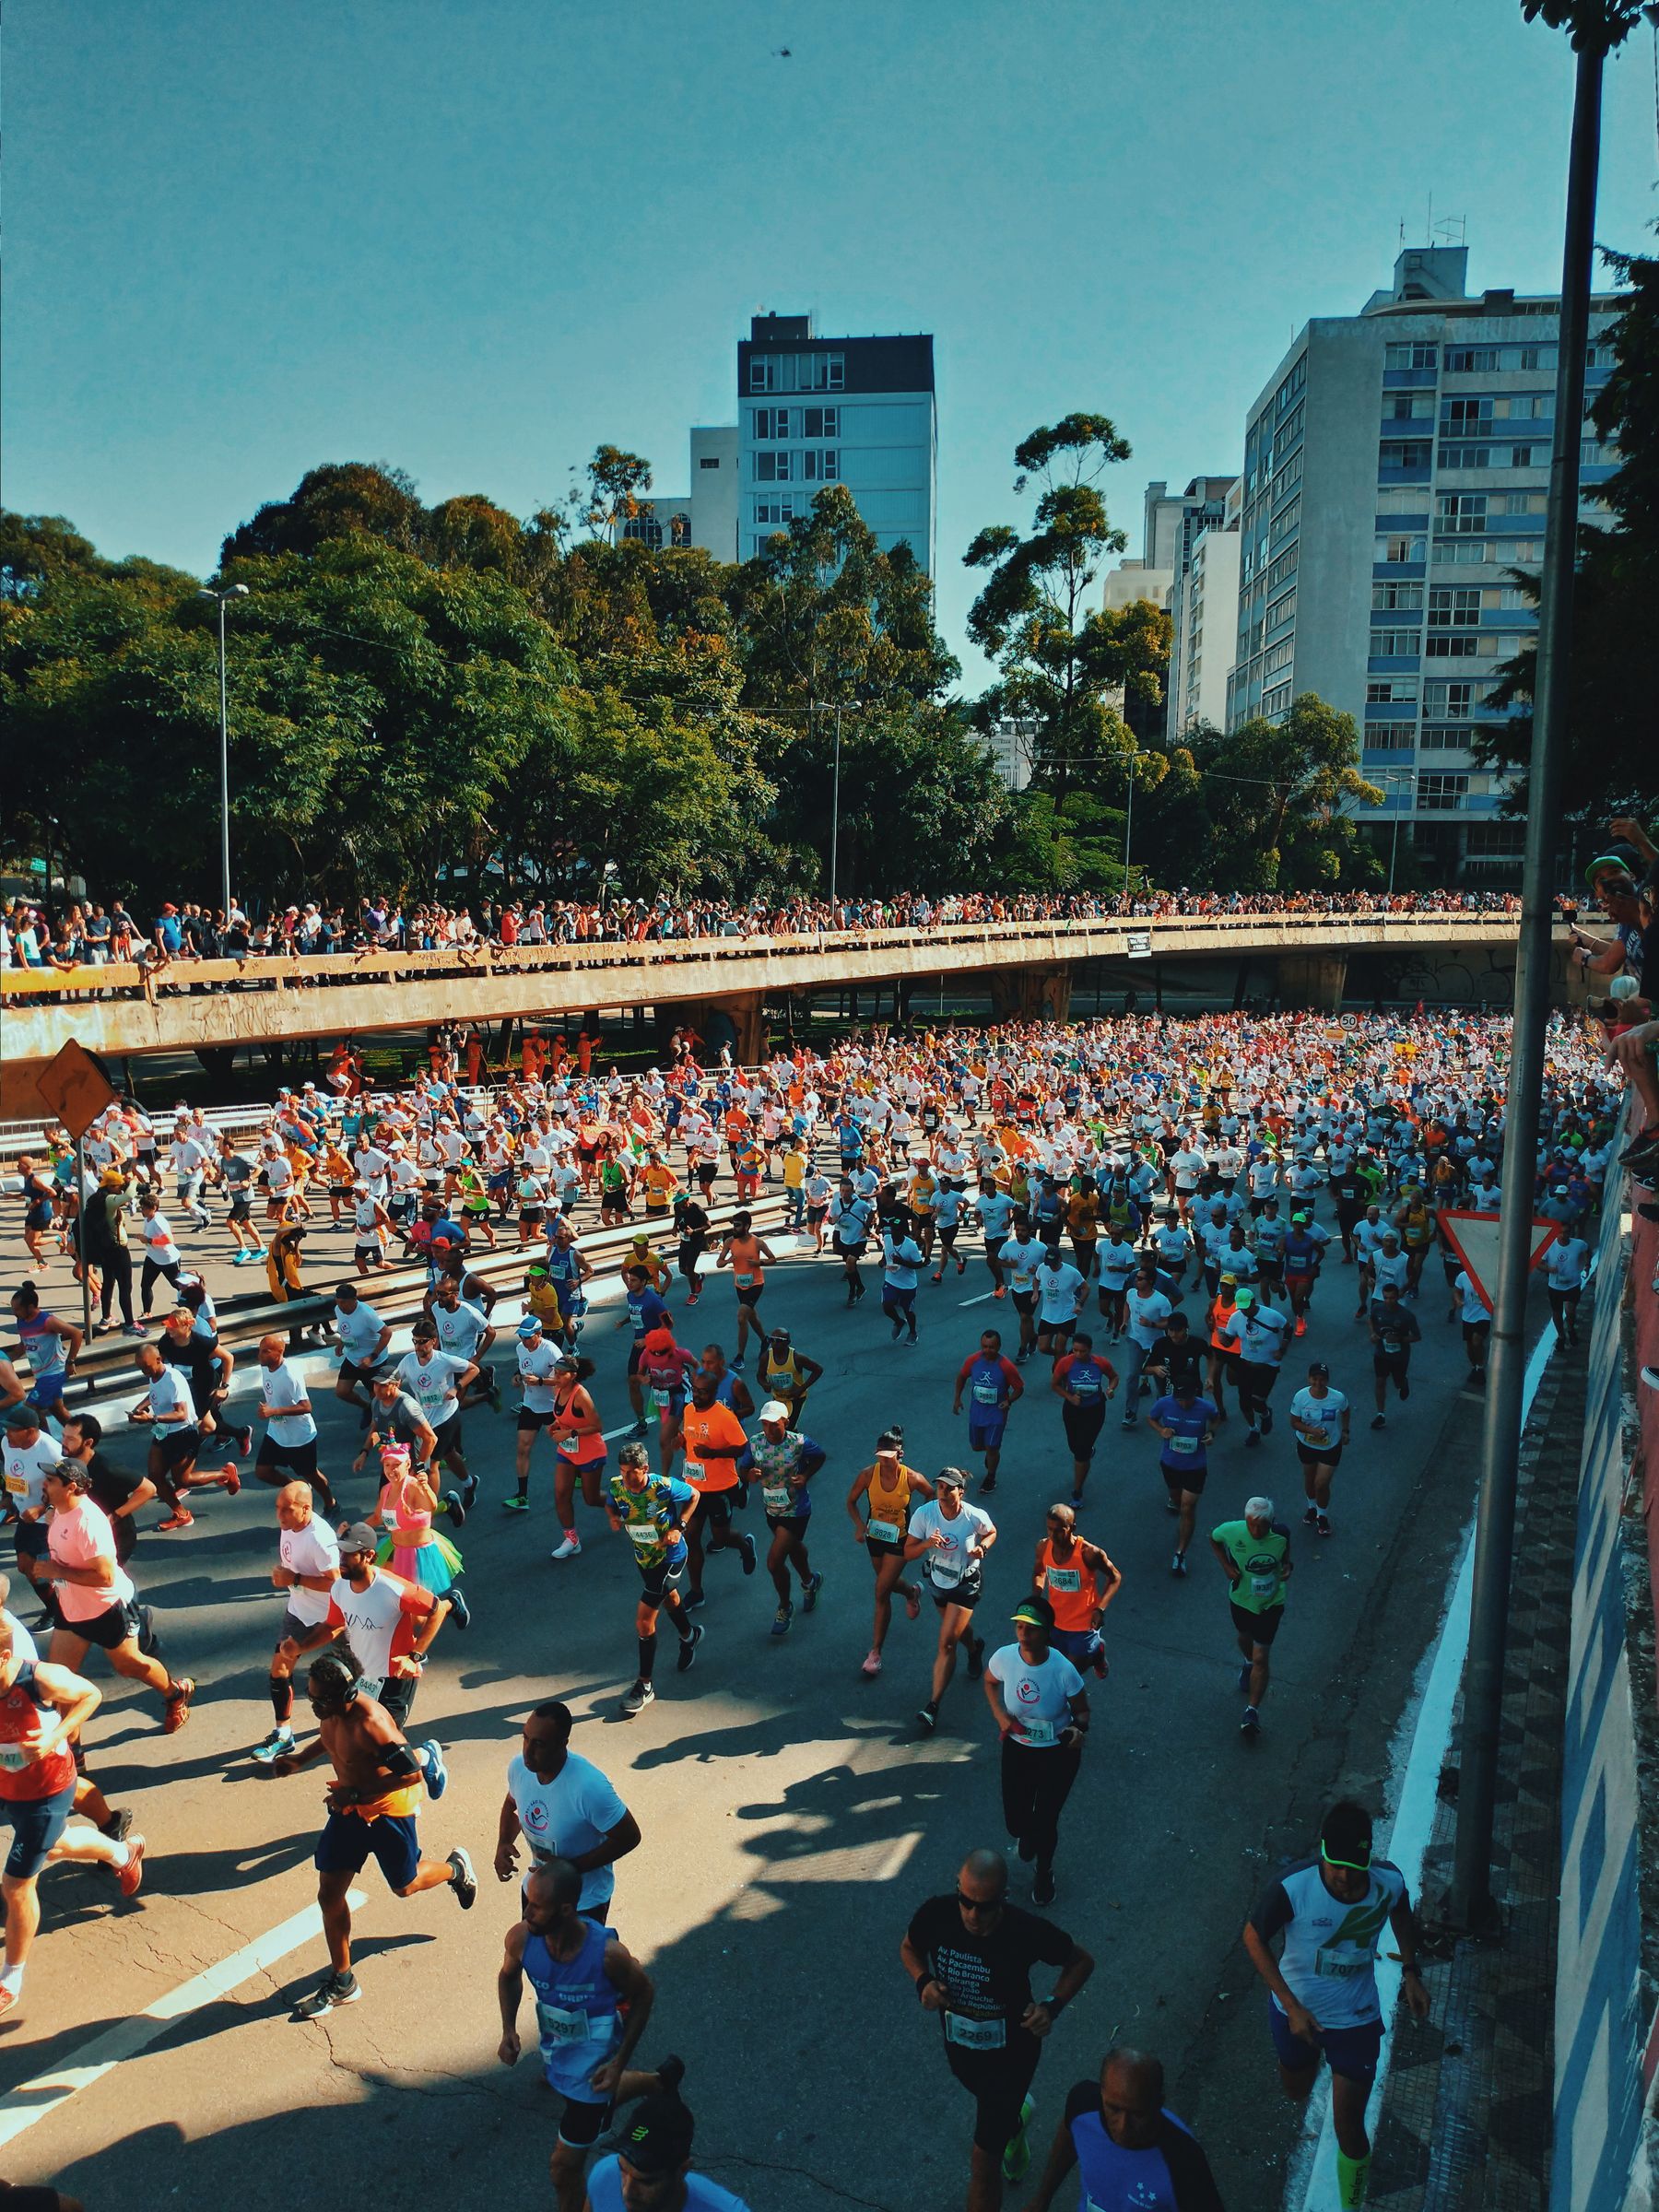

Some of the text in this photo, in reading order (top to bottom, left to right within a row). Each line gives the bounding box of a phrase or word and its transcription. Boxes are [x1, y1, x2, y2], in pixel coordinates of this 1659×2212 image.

[1342, 1016, 1356, 1026] 50
[937, 1946, 982, 1964] Av. Paulista
[936, 1954, 991, 1974] Av. Pacaembu
[947, 1967, 960, 1977] Rio
[961, 1971, 991, 1983] Branco
[947, 1975, 980, 1988] Ipiranga
[960, 1992, 994, 2003] Arouche
[547, 2018, 576, 2034] 5297
[959, 2028, 992, 2041] 2269
